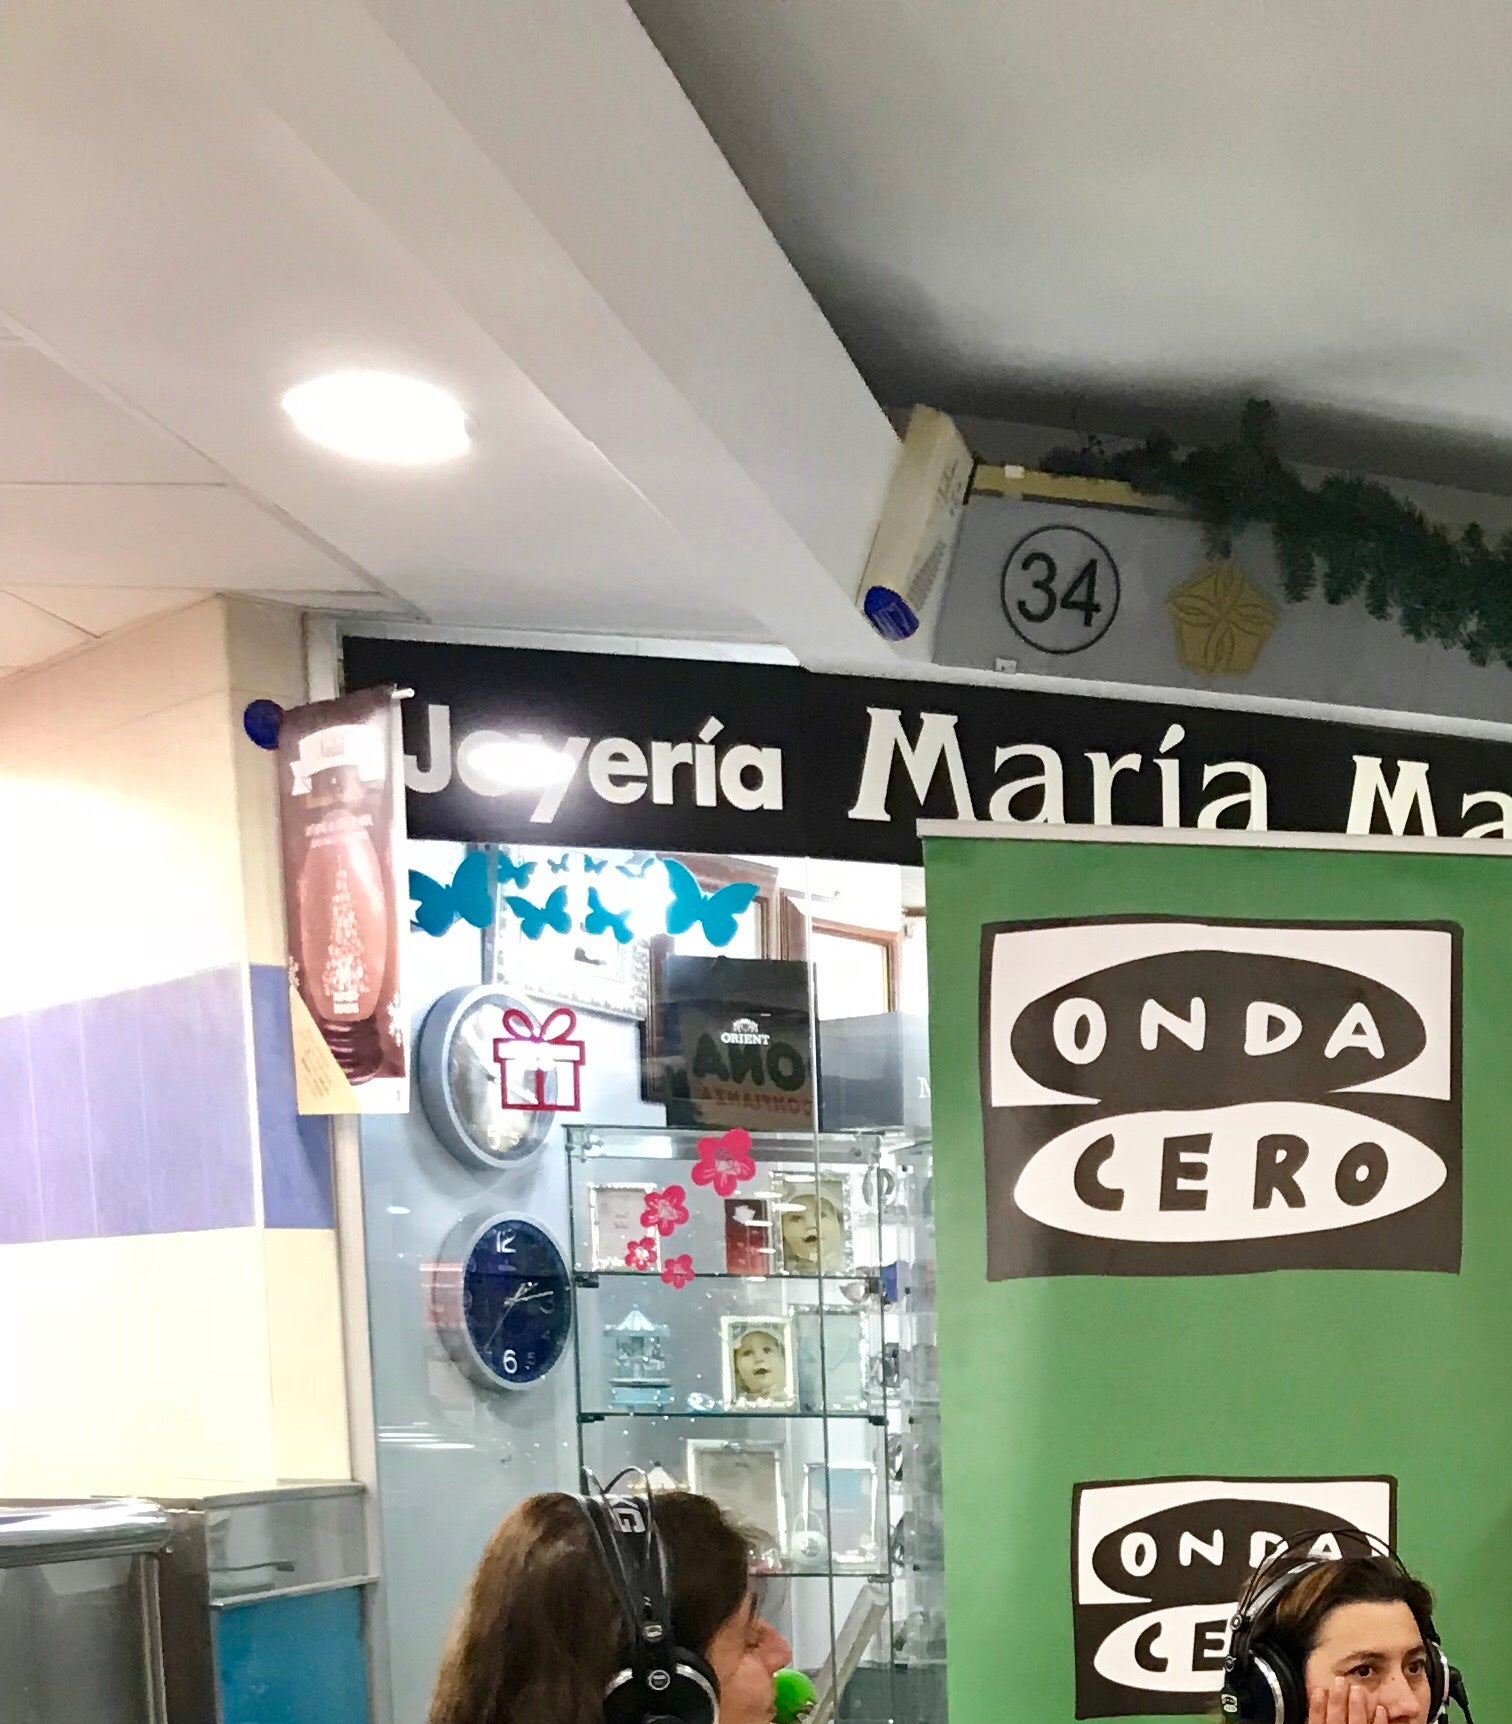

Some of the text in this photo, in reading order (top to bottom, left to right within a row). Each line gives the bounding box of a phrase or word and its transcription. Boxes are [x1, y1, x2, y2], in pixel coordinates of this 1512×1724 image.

[1017, 552, 1101, 627] 34
[847, 706, 1268, 832] María
[720, 1031, 770, 1046] ORIENT
[1052, 995, 1385, 1064] ONDA
[1073, 1132, 1389, 1213] CERO
[496, 1229, 517, 1253] 12
[503, 1348, 518, 1374] 6
[1120, 1528, 1343, 1577] ONDA
[1134, 1619, 1229, 1673] CE
